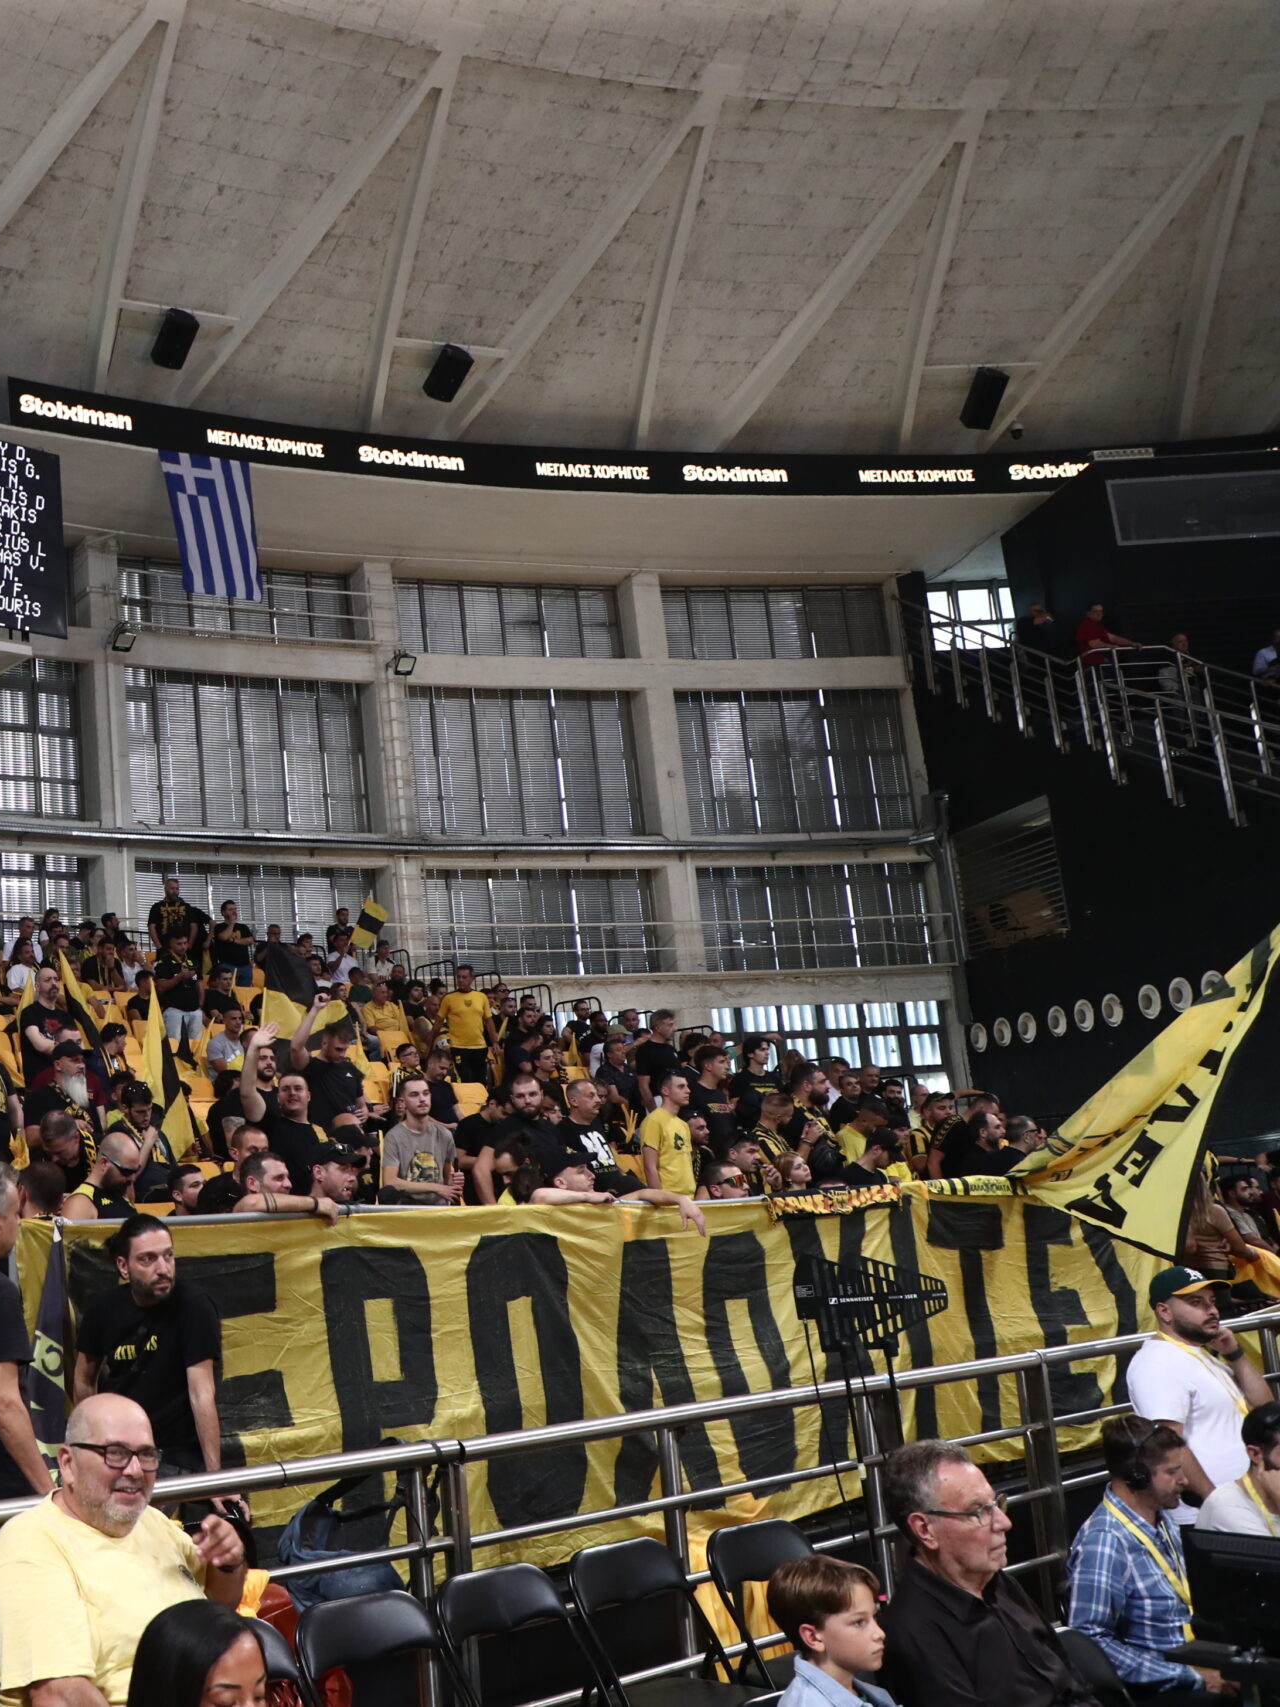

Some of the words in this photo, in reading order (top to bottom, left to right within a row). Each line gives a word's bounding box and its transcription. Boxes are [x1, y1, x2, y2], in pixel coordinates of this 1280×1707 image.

[19, 394, 133, 431] Stoiximan
[206, 428, 265, 451] ΜΕΓΑΛΟΣ
[265, 437, 325, 458] ΧΟΡΗΓΟΣ
[16, 447, 31, 463] D.
[358, 445, 465, 471] Stoiximan
[26, 464, 41, 480] G.
[535, 462, 592, 478] ΜΕΓΑΛΟΣ
[592, 465, 650, 480] ΧΟΡΗΓΟΣ
[682, 464, 789, 483] Stoiximan
[858, 469, 916, 483] ΜΕΓΑΛΟΣ
[916, 469, 976, 483] ΧΟΡΗΓΟΣ
[1008, 462, 1090, 481] Stoixim
[8, 475, 24, 491] N.
[35, 495, 45, 511] D
[11, 521, 26, 537] D.
[38, 541, 46, 557] L
[29, 555, 45, 572] V.
[3, 565, 19, 582] N.
[13, 583, 28, 599] F.
[16, 614, 30, 632] T.
[839, 1295, 874, 1303] SENNHEISER
